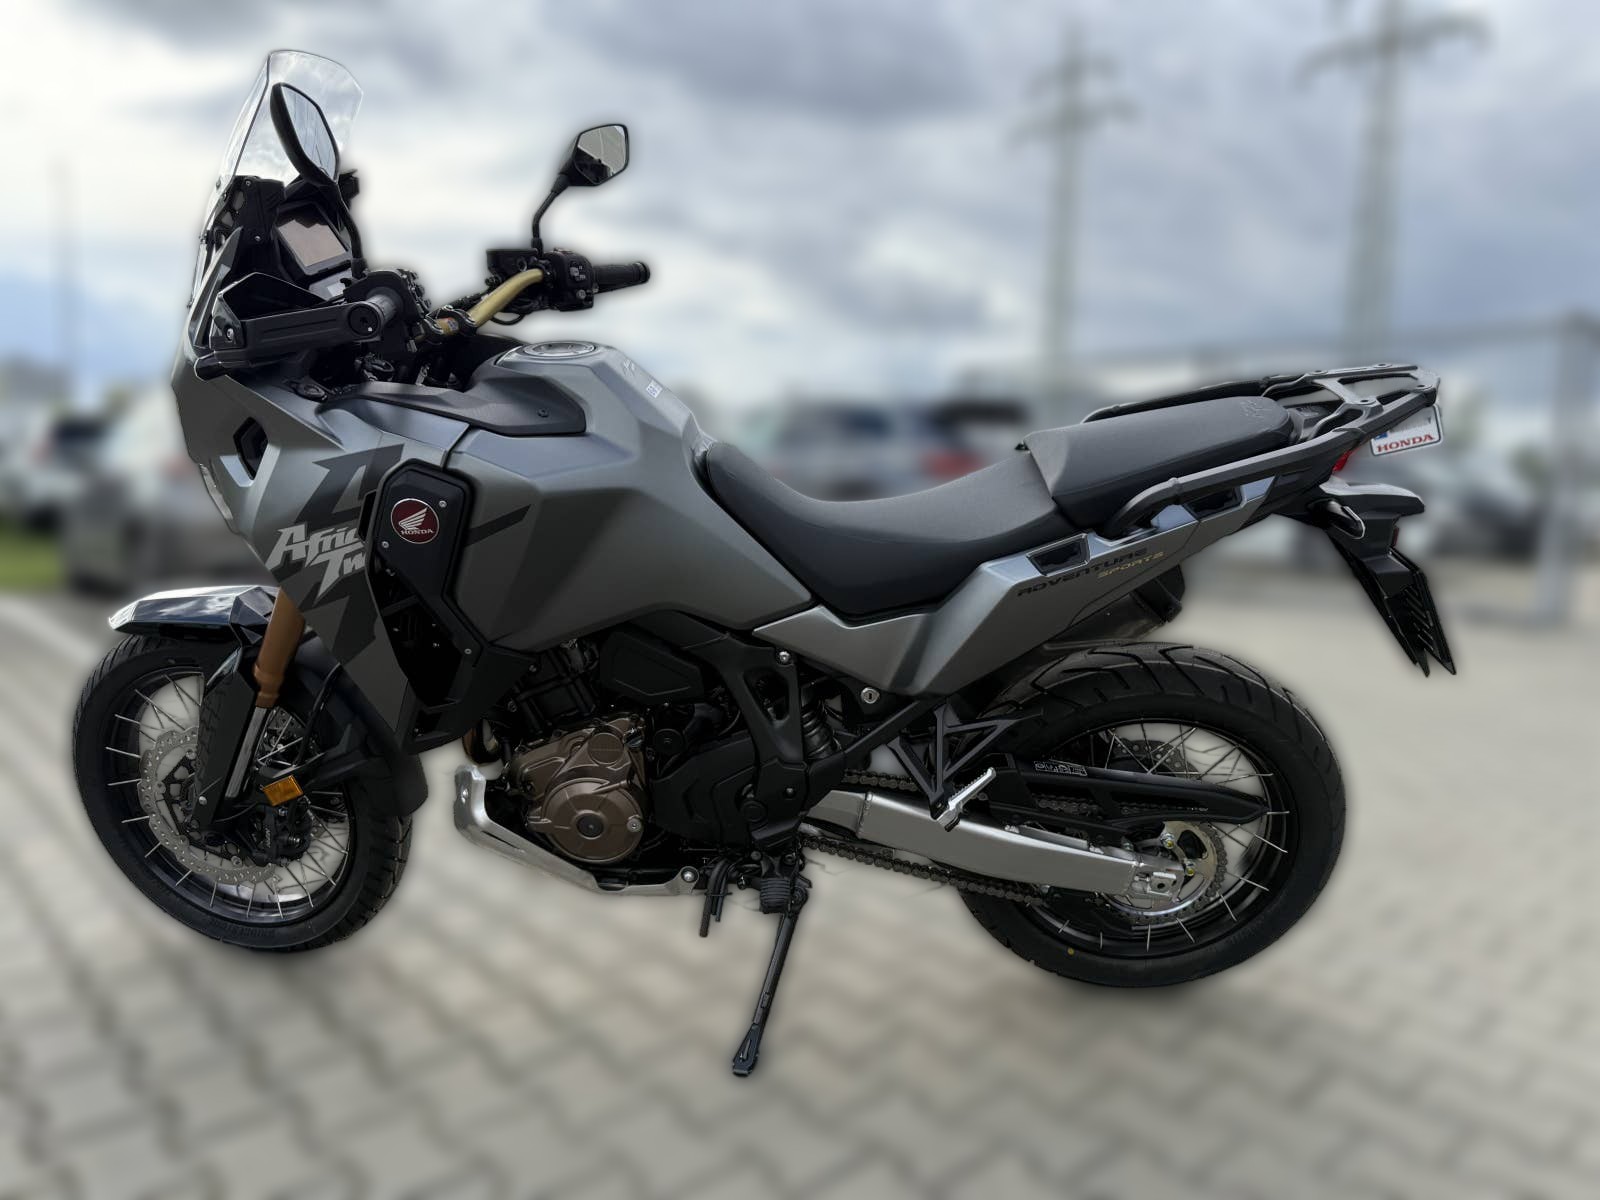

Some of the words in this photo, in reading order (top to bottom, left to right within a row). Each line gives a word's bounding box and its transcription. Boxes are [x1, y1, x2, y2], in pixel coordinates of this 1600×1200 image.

[1377, 433, 1435, 453] HONDA
[264, 523, 361, 570] Afric
[309, 541, 367, 598] Tw
[1097, 550, 1165, 579] SPORTS
[1017, 547, 1149, 597] ADVENTURE
